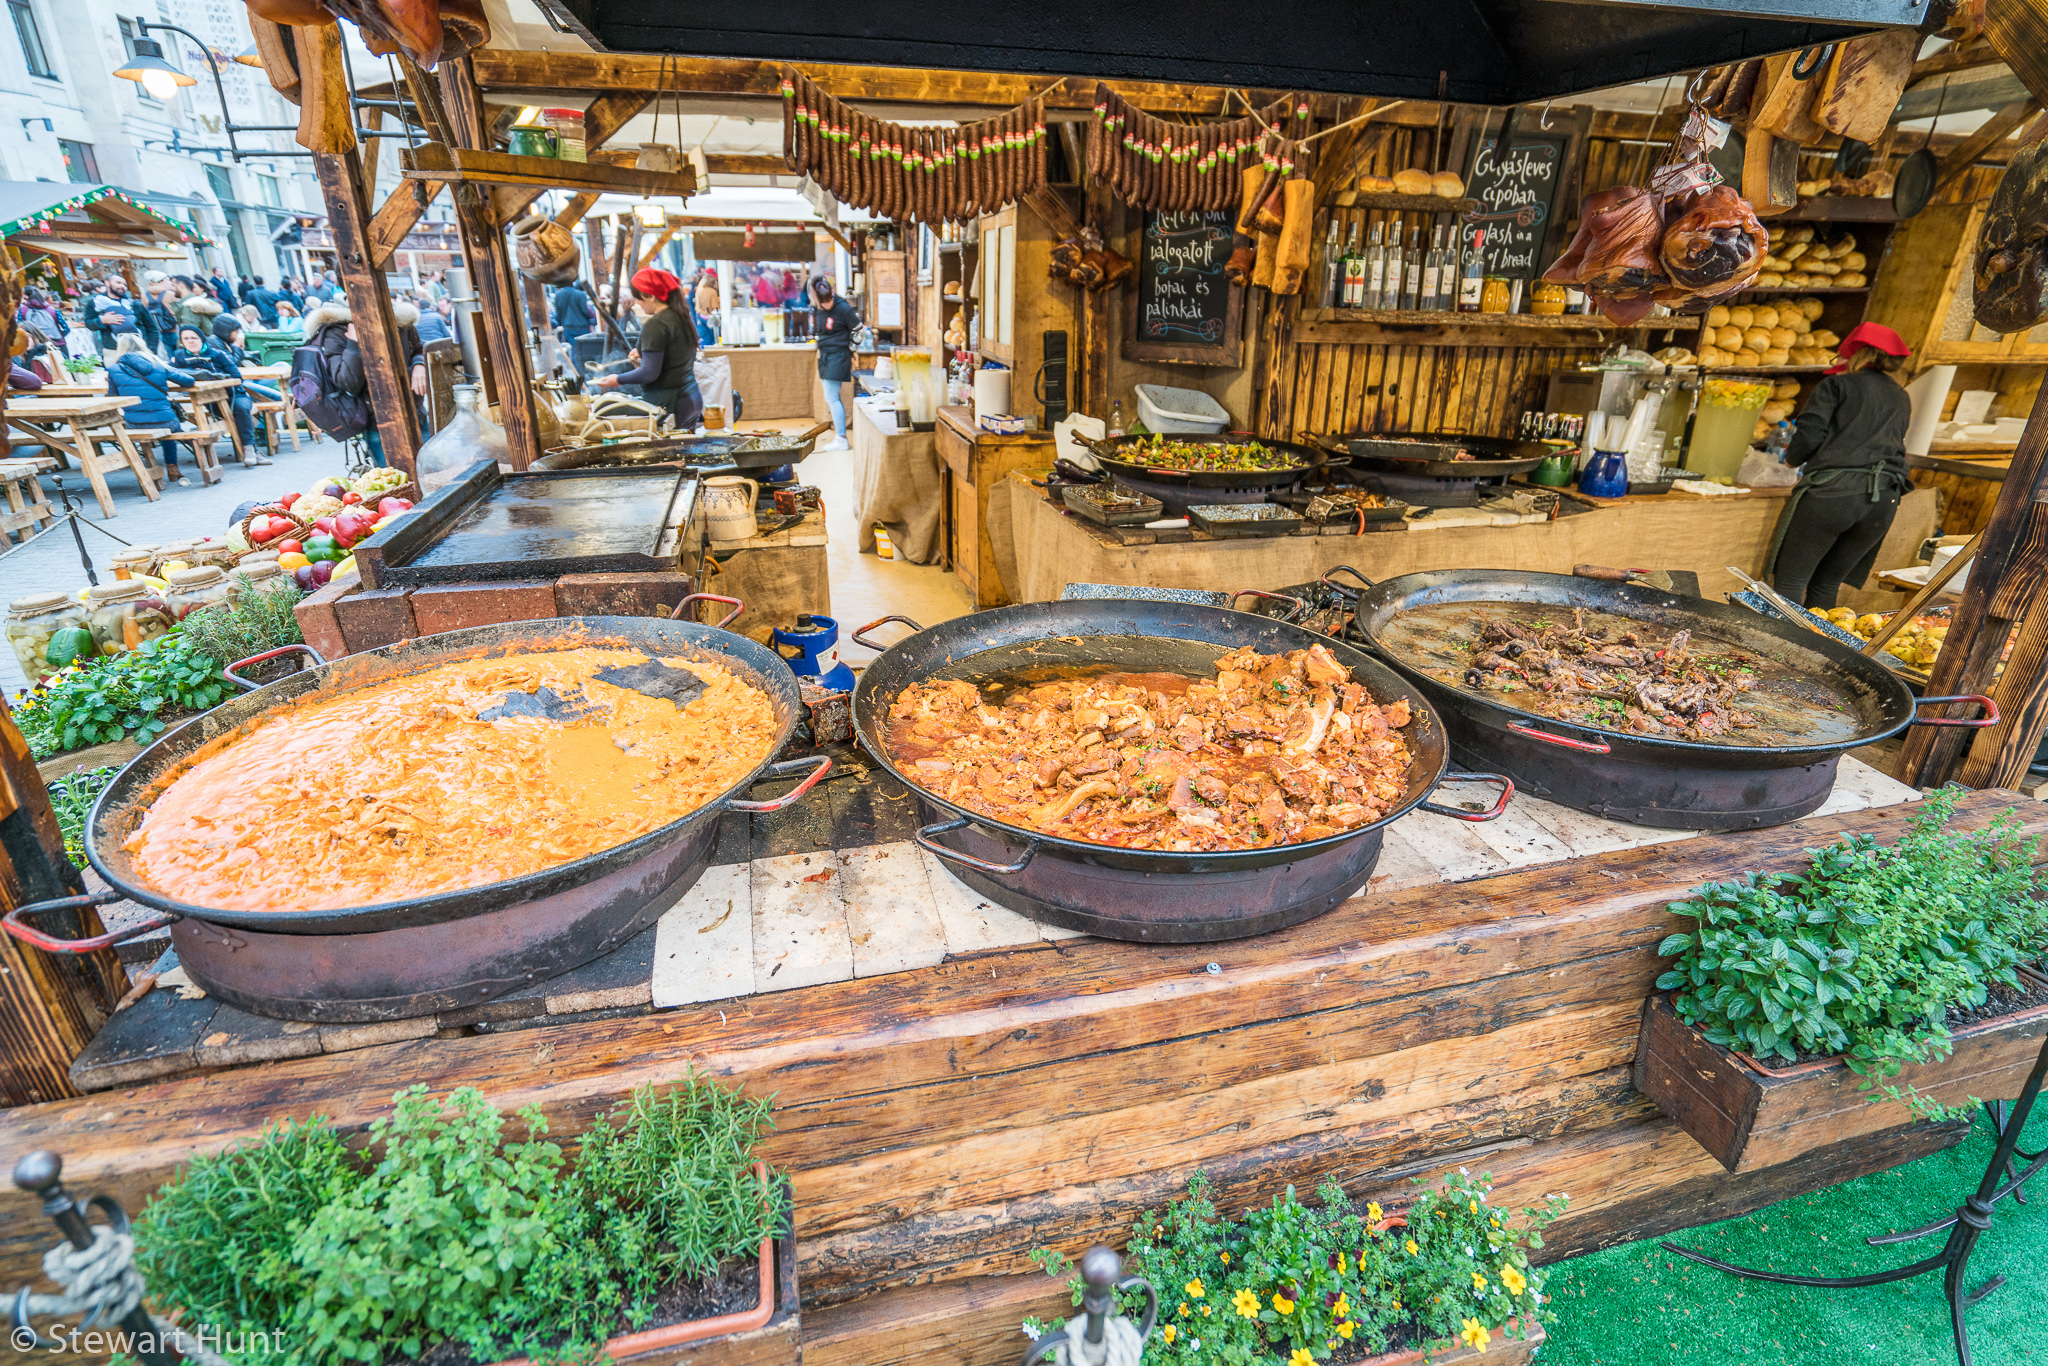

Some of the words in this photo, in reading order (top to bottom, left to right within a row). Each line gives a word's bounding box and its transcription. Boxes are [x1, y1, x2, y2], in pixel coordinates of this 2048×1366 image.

[187, 50, 212, 61] Har
[1483, 179, 1537, 211] cipóban
[1516, 229, 1525, 240] in
[1525, 231, 1532, 241] a
[1488, 247, 1500, 272] of
[1500, 248, 1533, 269] bread
